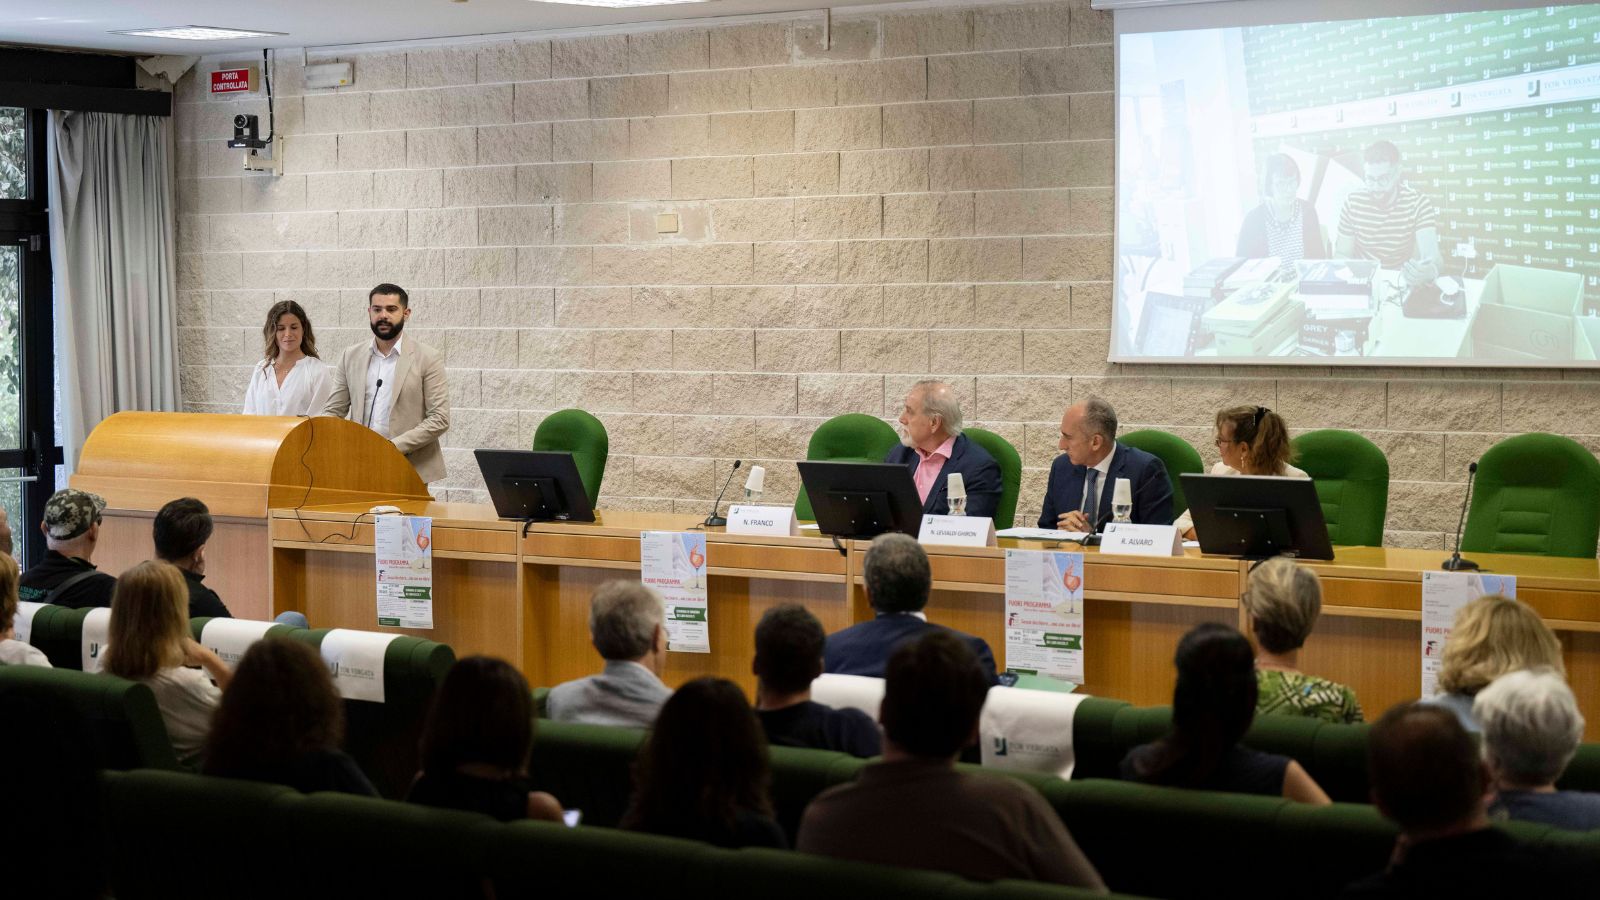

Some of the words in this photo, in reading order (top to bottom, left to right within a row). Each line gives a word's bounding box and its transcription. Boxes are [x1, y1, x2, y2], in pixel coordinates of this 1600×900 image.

[222, 72, 239, 80] PORTA
[213, 81, 248, 91] CONTROLLATA
[751, 519, 774, 527] FRANCO
[1121, 537, 1128, 545] R.
[1128, 538, 1154, 546] ALVARO
[1008, 599, 1023, 608] FUORI
